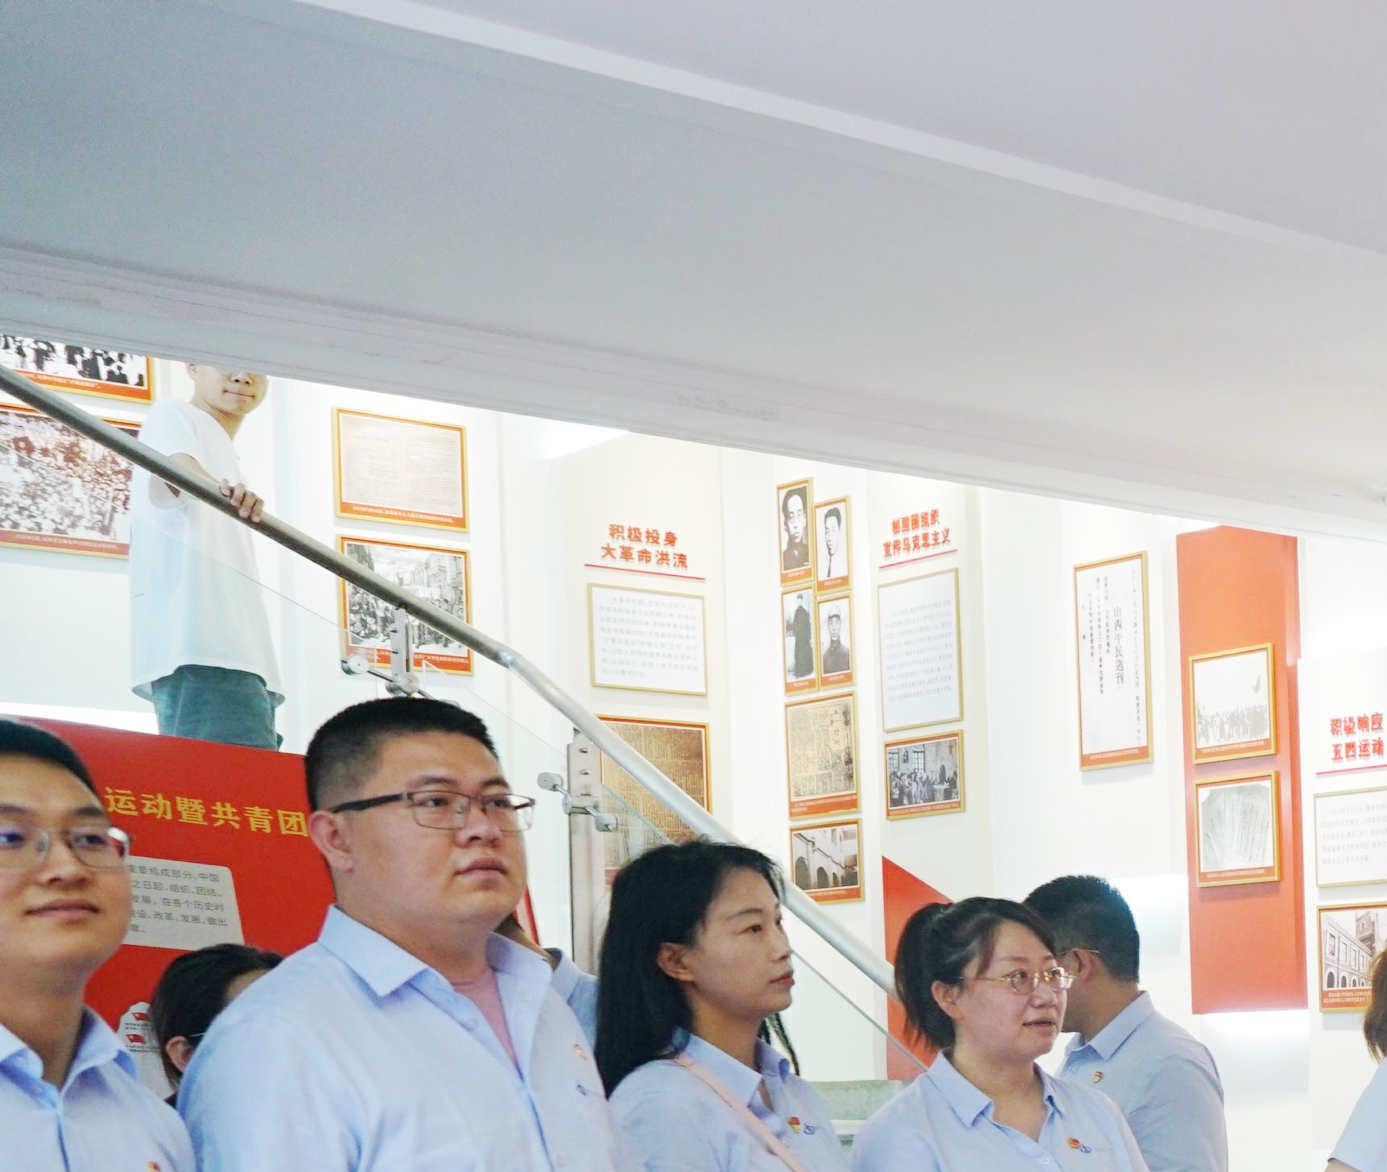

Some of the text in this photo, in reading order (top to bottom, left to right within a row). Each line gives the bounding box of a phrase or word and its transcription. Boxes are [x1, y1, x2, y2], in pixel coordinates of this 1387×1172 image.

[608, 523, 678, 547] 积极投身
[601, 543, 689, 569] 大革命洪流
[105, 787, 309, 836] 运动暨共青团
